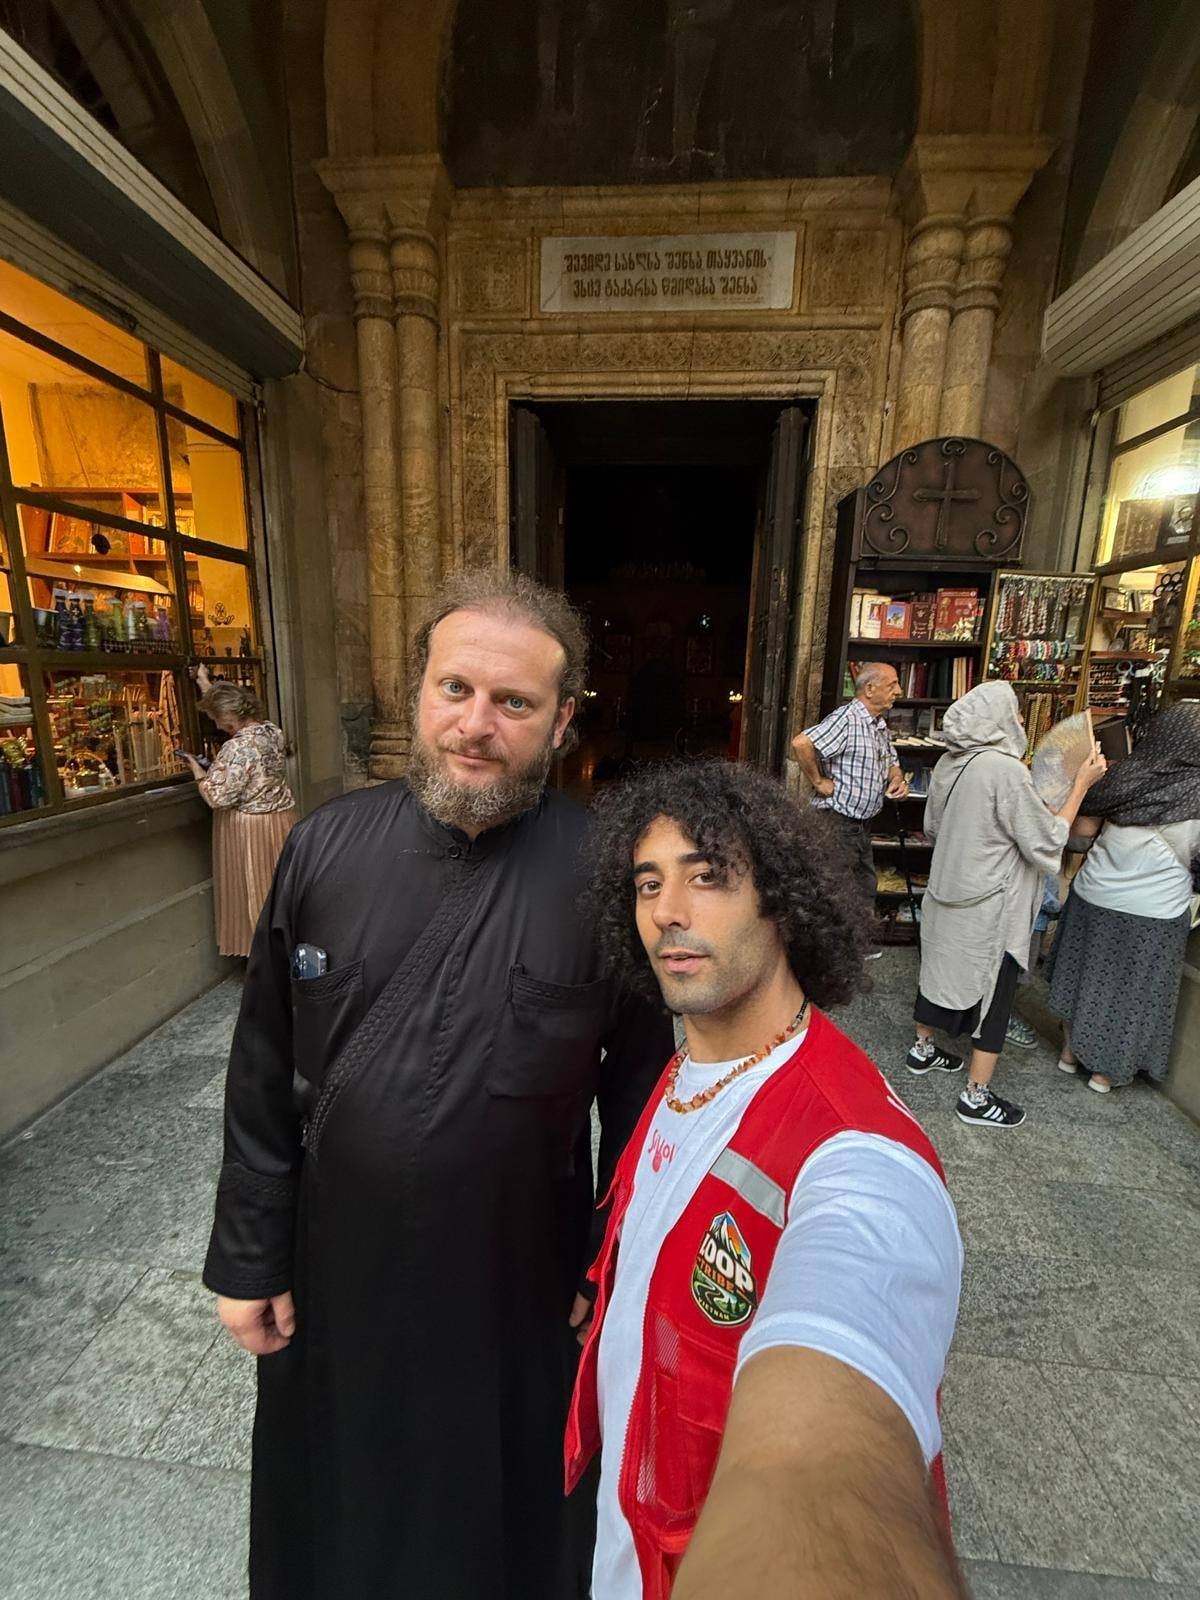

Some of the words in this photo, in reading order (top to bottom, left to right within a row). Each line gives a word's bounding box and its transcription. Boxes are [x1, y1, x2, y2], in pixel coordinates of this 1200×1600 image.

[564, 253, 611, 273] შევიდე
[614, 252, 661, 272] სახლსა
[664, 250, 703, 270] შენსა
[573, 279, 602, 298] ვსცე
[604, 277, 658, 298] ტაძარსა
[661, 276, 716, 297] წმიდასა
[699, 1232, 754, 1293] LOOP
[699, 1259, 735, 1294] TRIBE
[698, 1297, 731, 1321] VIETNAM
